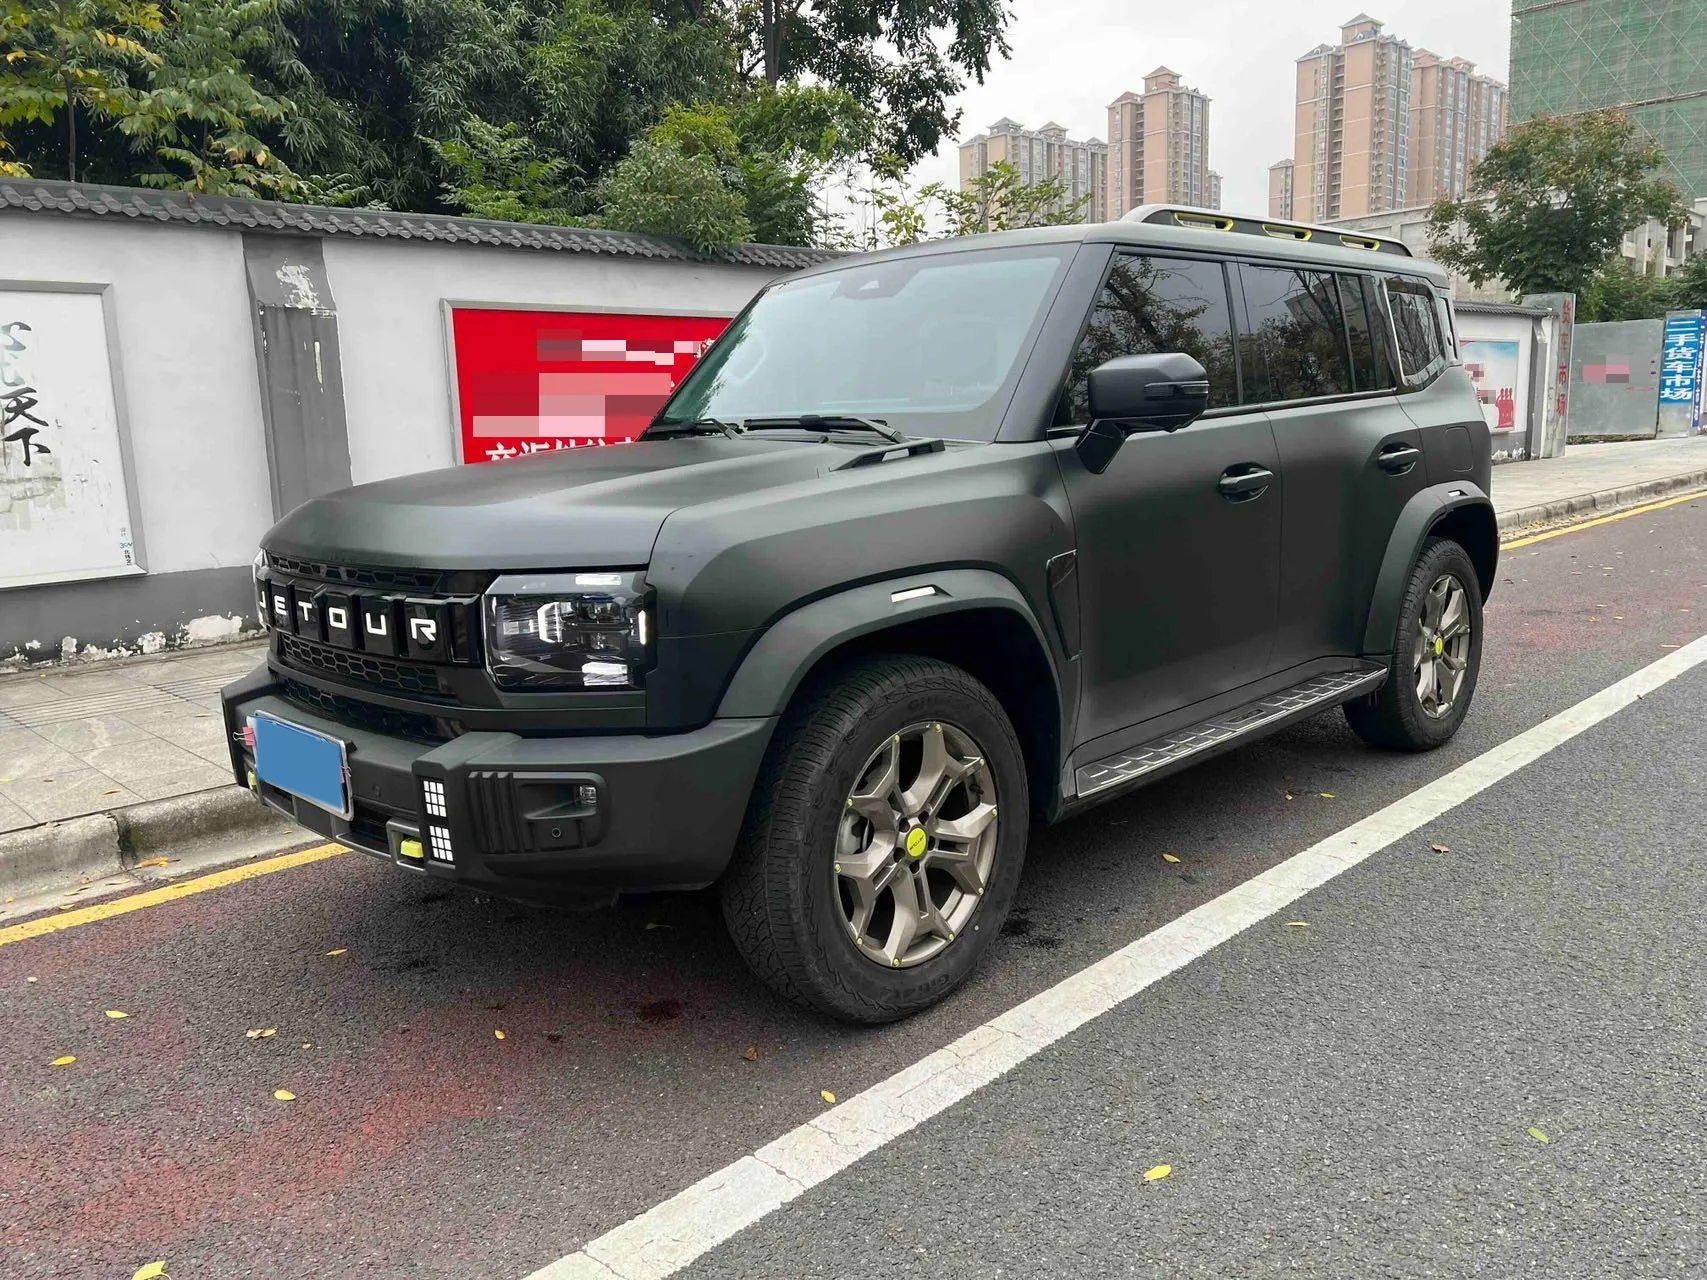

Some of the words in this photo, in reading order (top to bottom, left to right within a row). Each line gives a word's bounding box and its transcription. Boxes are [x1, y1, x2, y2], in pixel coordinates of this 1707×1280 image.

[1661, 319, 1699, 401] 二手货车市场
[258, 590, 438, 642] JETOUR
